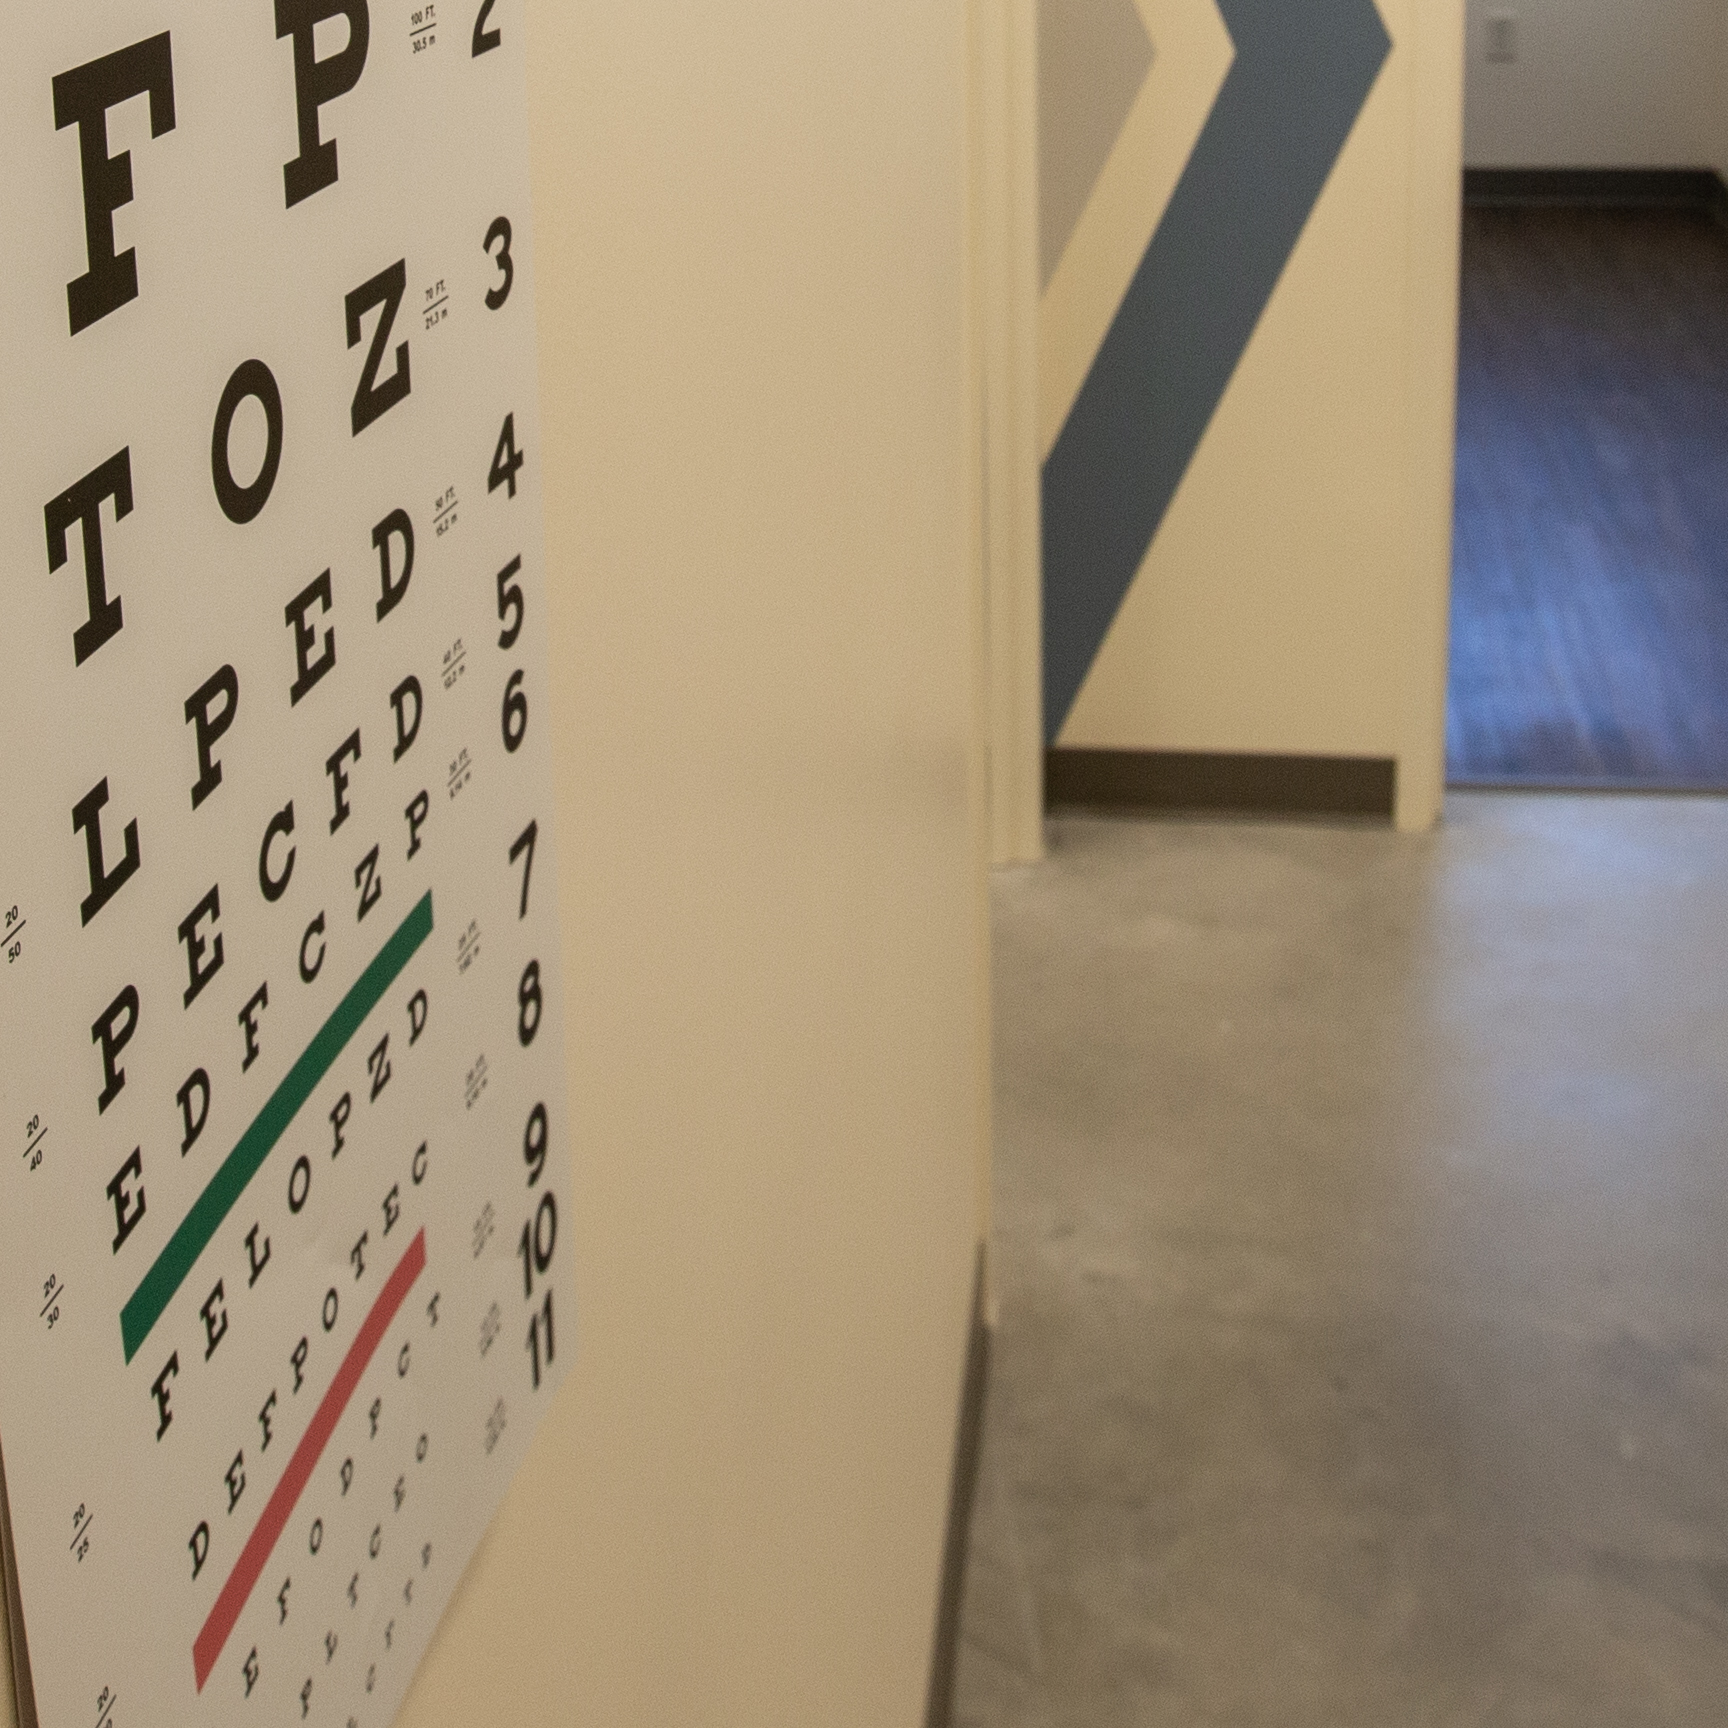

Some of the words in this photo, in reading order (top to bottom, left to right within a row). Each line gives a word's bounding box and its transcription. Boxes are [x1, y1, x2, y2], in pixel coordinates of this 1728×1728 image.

[51, 30, 176, 337] F
[482, 216, 514, 311] 3
[43, 445, 134, 667] T
[211, 358, 284, 525] O
[344, 258, 412, 437] Z
[487, 412, 524, 499] 4
[496, 554, 525, 651] 5
[71, 776, 141, 928] L
[184, 664, 239, 811] P
[284, 567, 337, 707] E
[371, 508, 415, 623] D
[501, 668, 528, 754] 6
[5, 905, 18, 928] 20
[91, 984, 140, 1115] P
[177, 883, 225, 1010] E
[258, 800, 297, 903] C
[325, 728, 362, 835] F
[389, 674, 423, 763] D
[508, 819, 538, 920] 7
[8, 941, 22, 964] 50
[105, 1146, 147, 1255] E
[176, 1067, 211, 1157] D
[237, 981, 269, 1073] F
[298, 910, 326, 984] C
[354, 843, 382, 922] Z
[404, 789, 430, 861] P
[517, 958, 543, 1048] 8
[26, 1114, 39, 1138] 20
[29, 1149, 43, 1172] 40
[523, 1101, 549, 1188] 9
[150, 1350, 180, 1442] F
[199, 1278, 229, 1362] E
[244, 1222, 271, 1288] L
[287, 1155, 312, 1215] O
[328, 1091, 352, 1159] P
[367, 1033, 392, 1103] Z
[406, 988, 428, 1046] D
[517, 1190, 558, 1300] 10
[44, 1273, 56, 1298] 20
[47, 1305, 59, 1330] 30
[188, 1520, 210, 1580] D
[224, 1450, 246, 1514] E
[258, 1390, 278, 1452] F
[290, 1336, 309, 1394] P
[322, 1287, 339, 1332] O
[350, 1231, 369, 1280] T
[382, 1184, 400, 1236] E
[412, 1141, 427, 1186] C
[526, 1289, 555, 1391] 11
[242, 1645, 259, 1698] E
[277, 1576, 291, 1625] F
[309, 1517, 323, 1556] O
